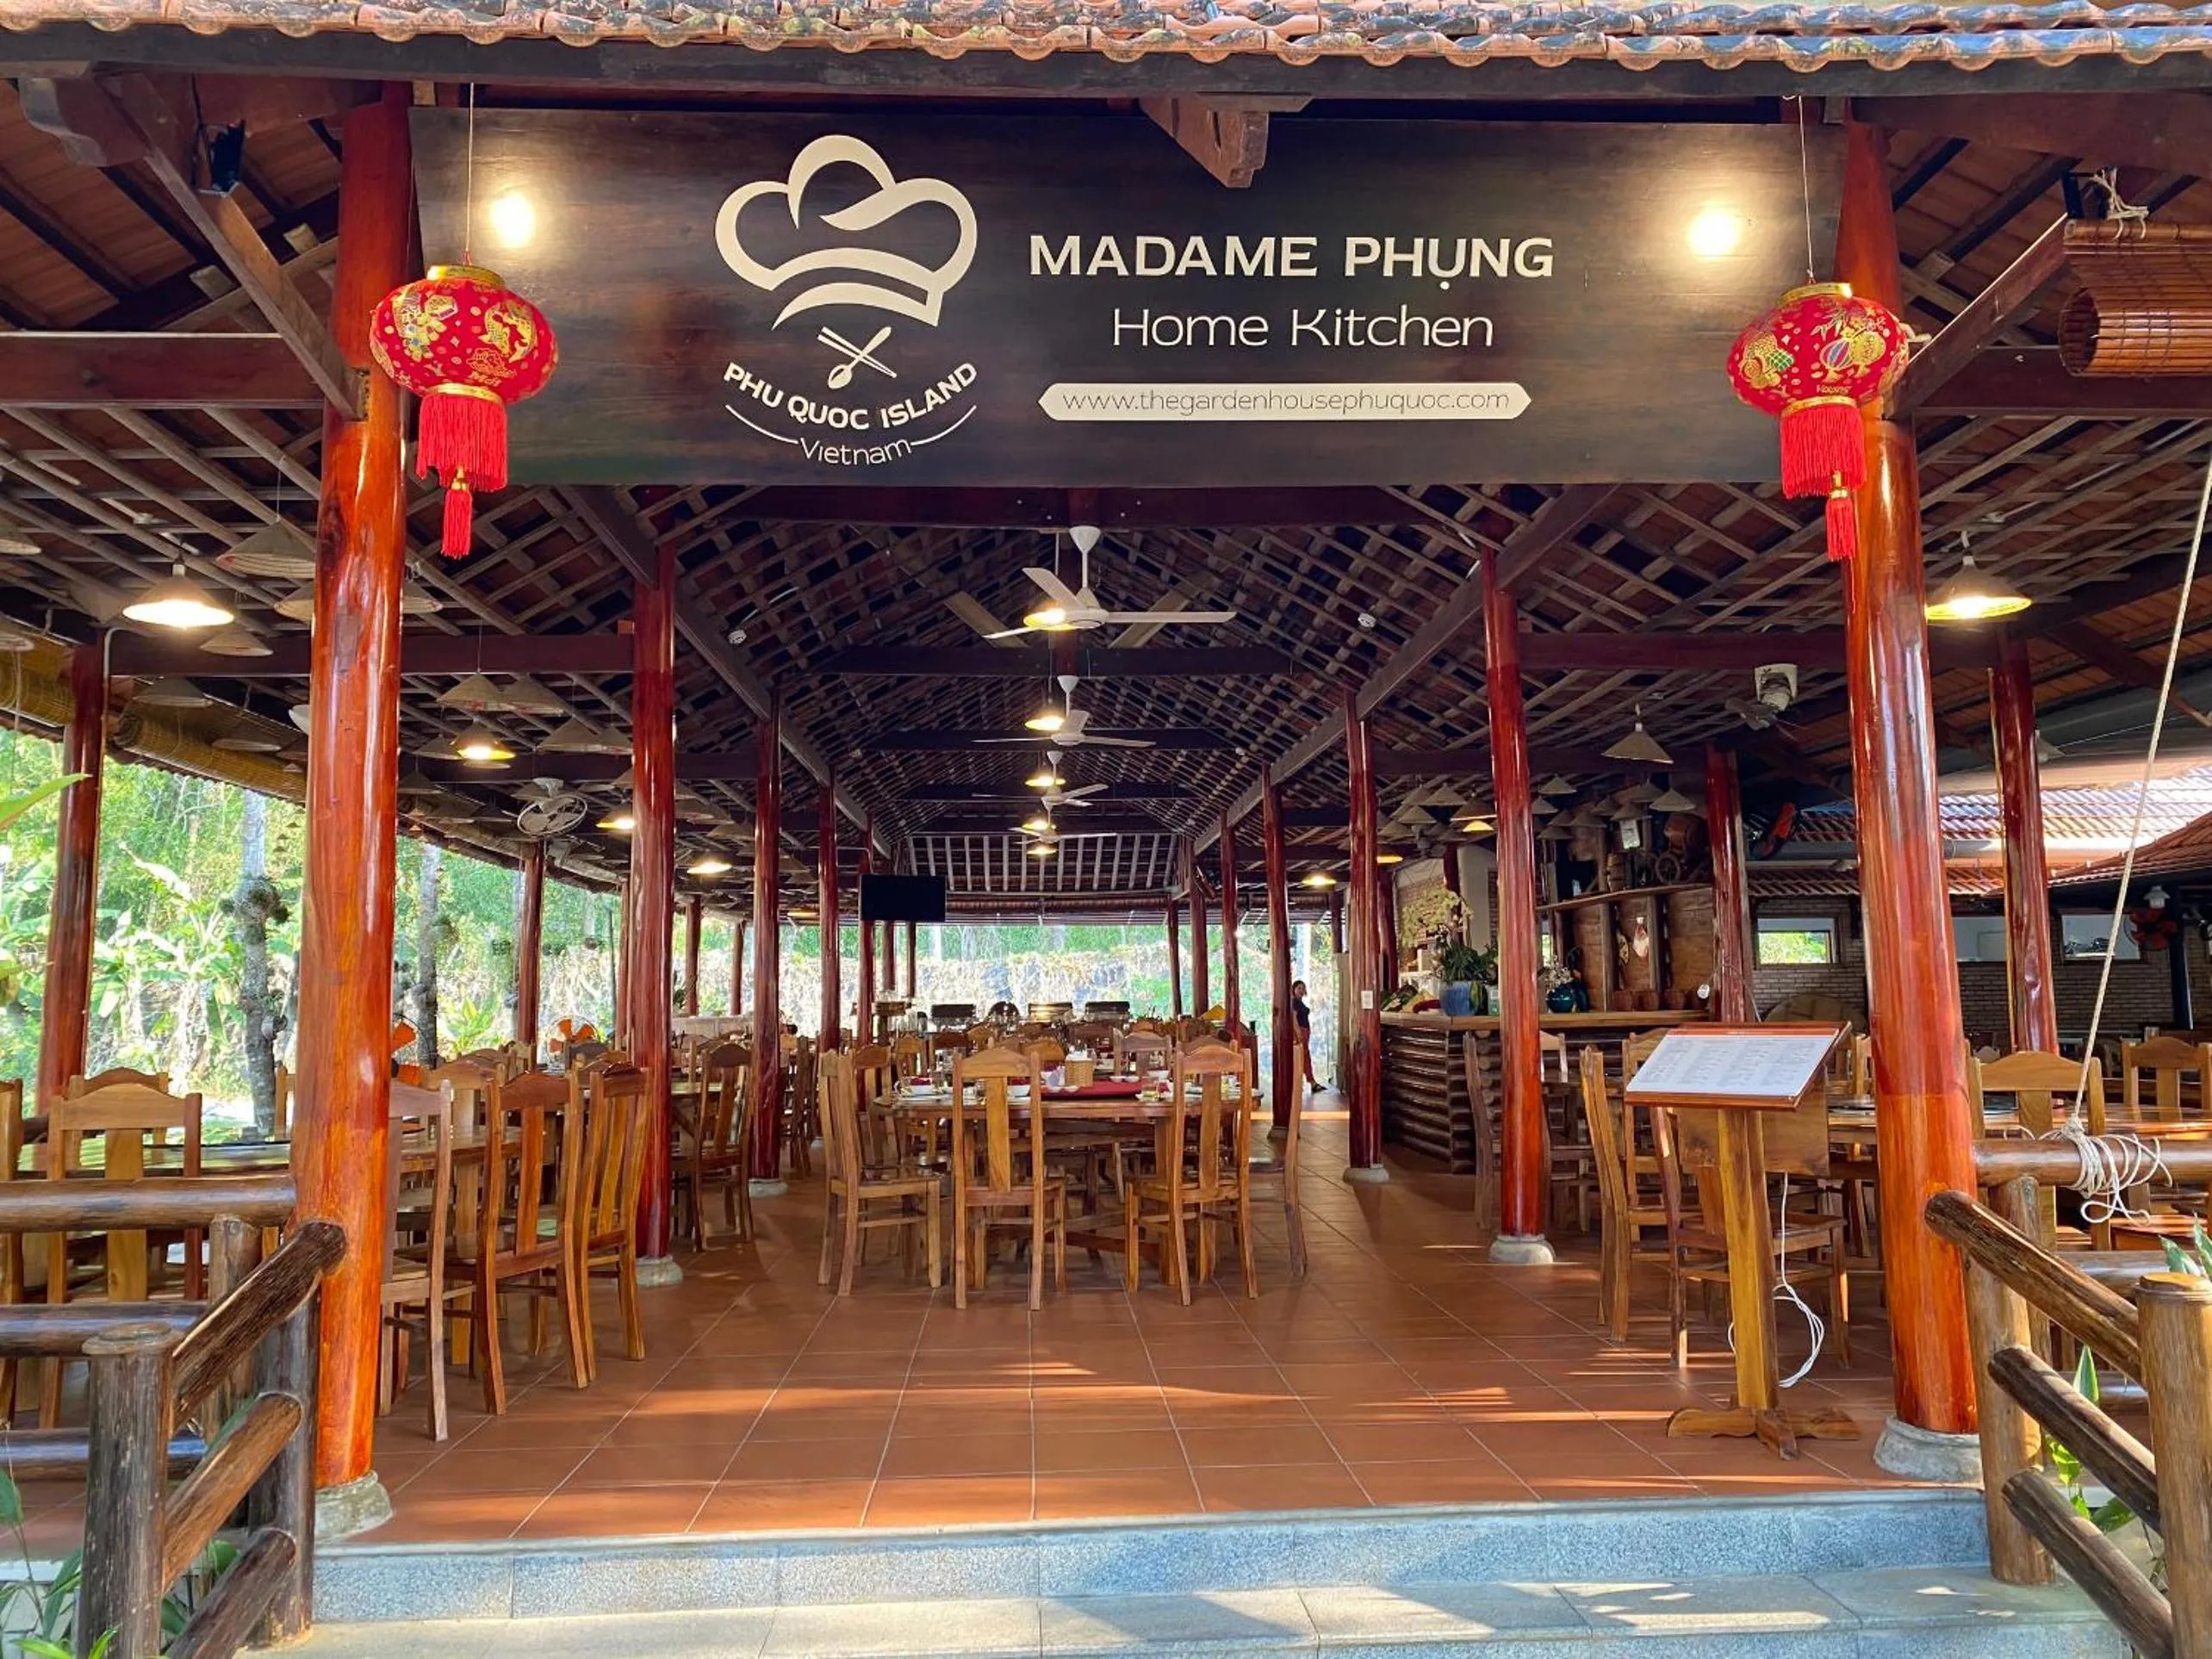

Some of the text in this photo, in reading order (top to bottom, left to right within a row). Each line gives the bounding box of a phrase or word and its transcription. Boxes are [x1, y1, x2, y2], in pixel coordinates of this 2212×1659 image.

[1029, 234, 1555, 290] MADAME PHỤNG
[1112, 304, 1494, 347] Home Kitchen
[724, 362, 978, 431] PHU QUOC ISLAND
[1062, 389, 1510, 417] www.thegardenhousephuquoc.com
[799, 437, 913, 466] Vietnam
